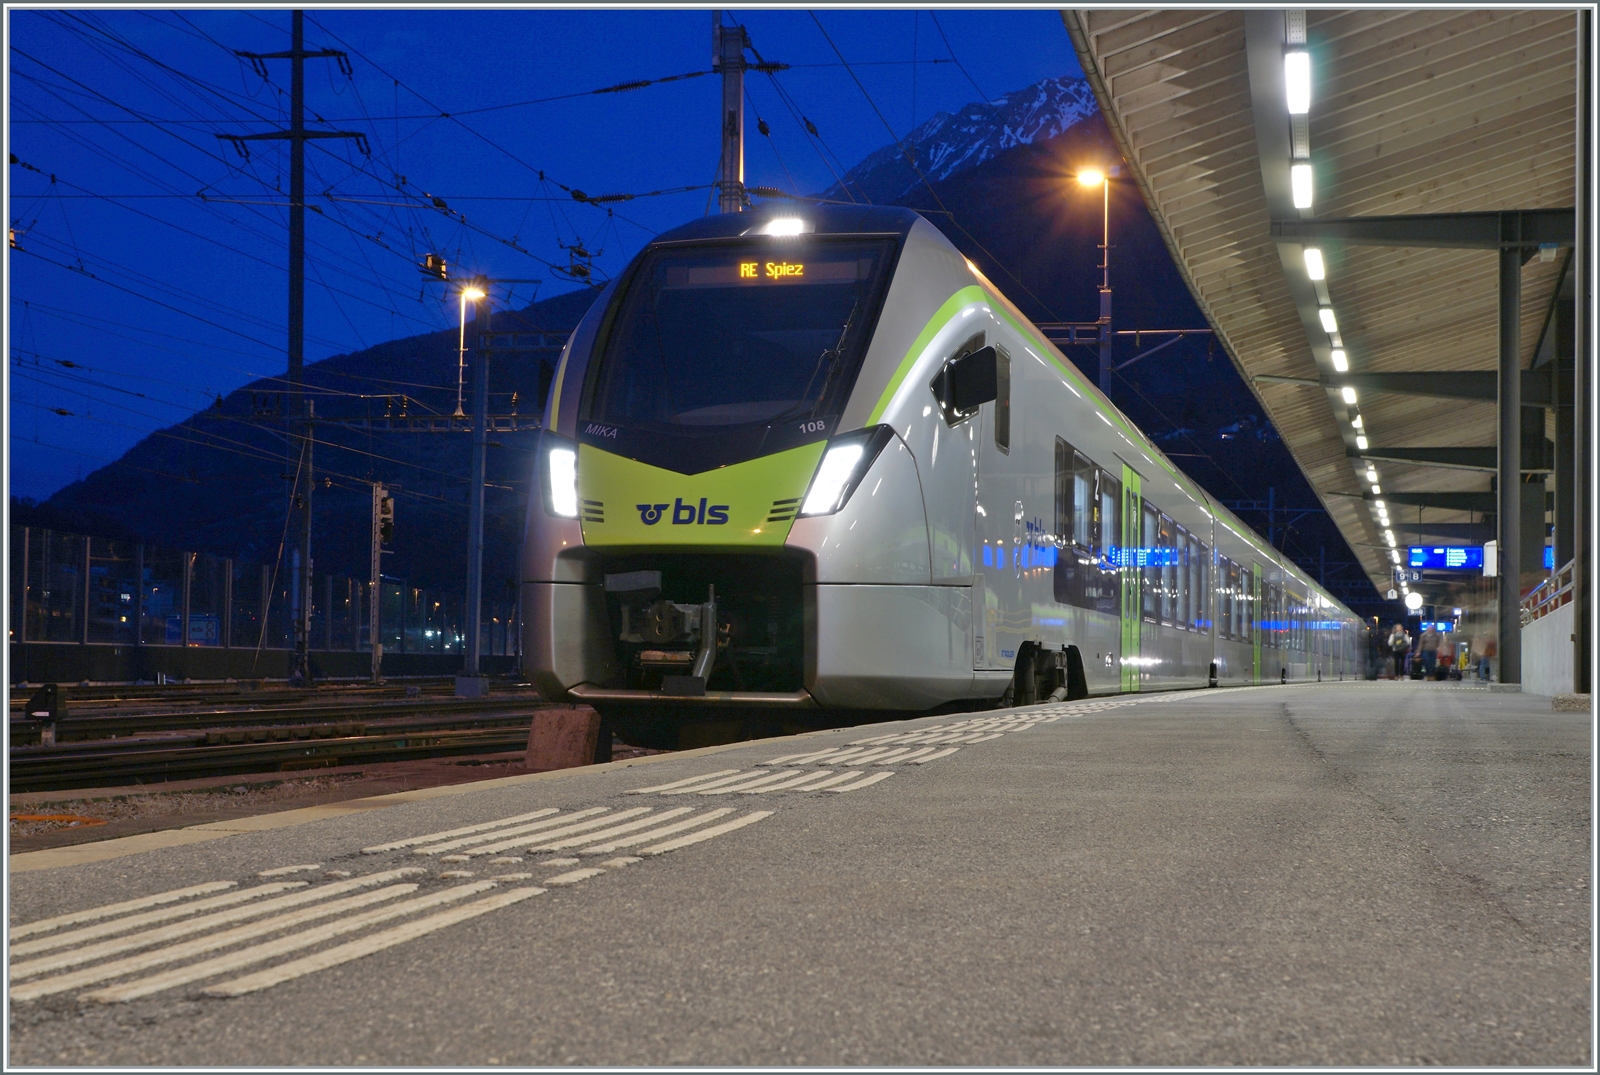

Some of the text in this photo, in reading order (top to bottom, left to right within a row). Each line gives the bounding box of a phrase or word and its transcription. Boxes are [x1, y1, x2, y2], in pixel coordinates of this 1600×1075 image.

[740, 262, 804, 279] RE Spiez
[584, 423, 618, 439] MIKA
[799, 420, 825, 434] 108
[672, 497, 730, 525] bls
[1399, 573, 1405, 581] 9
